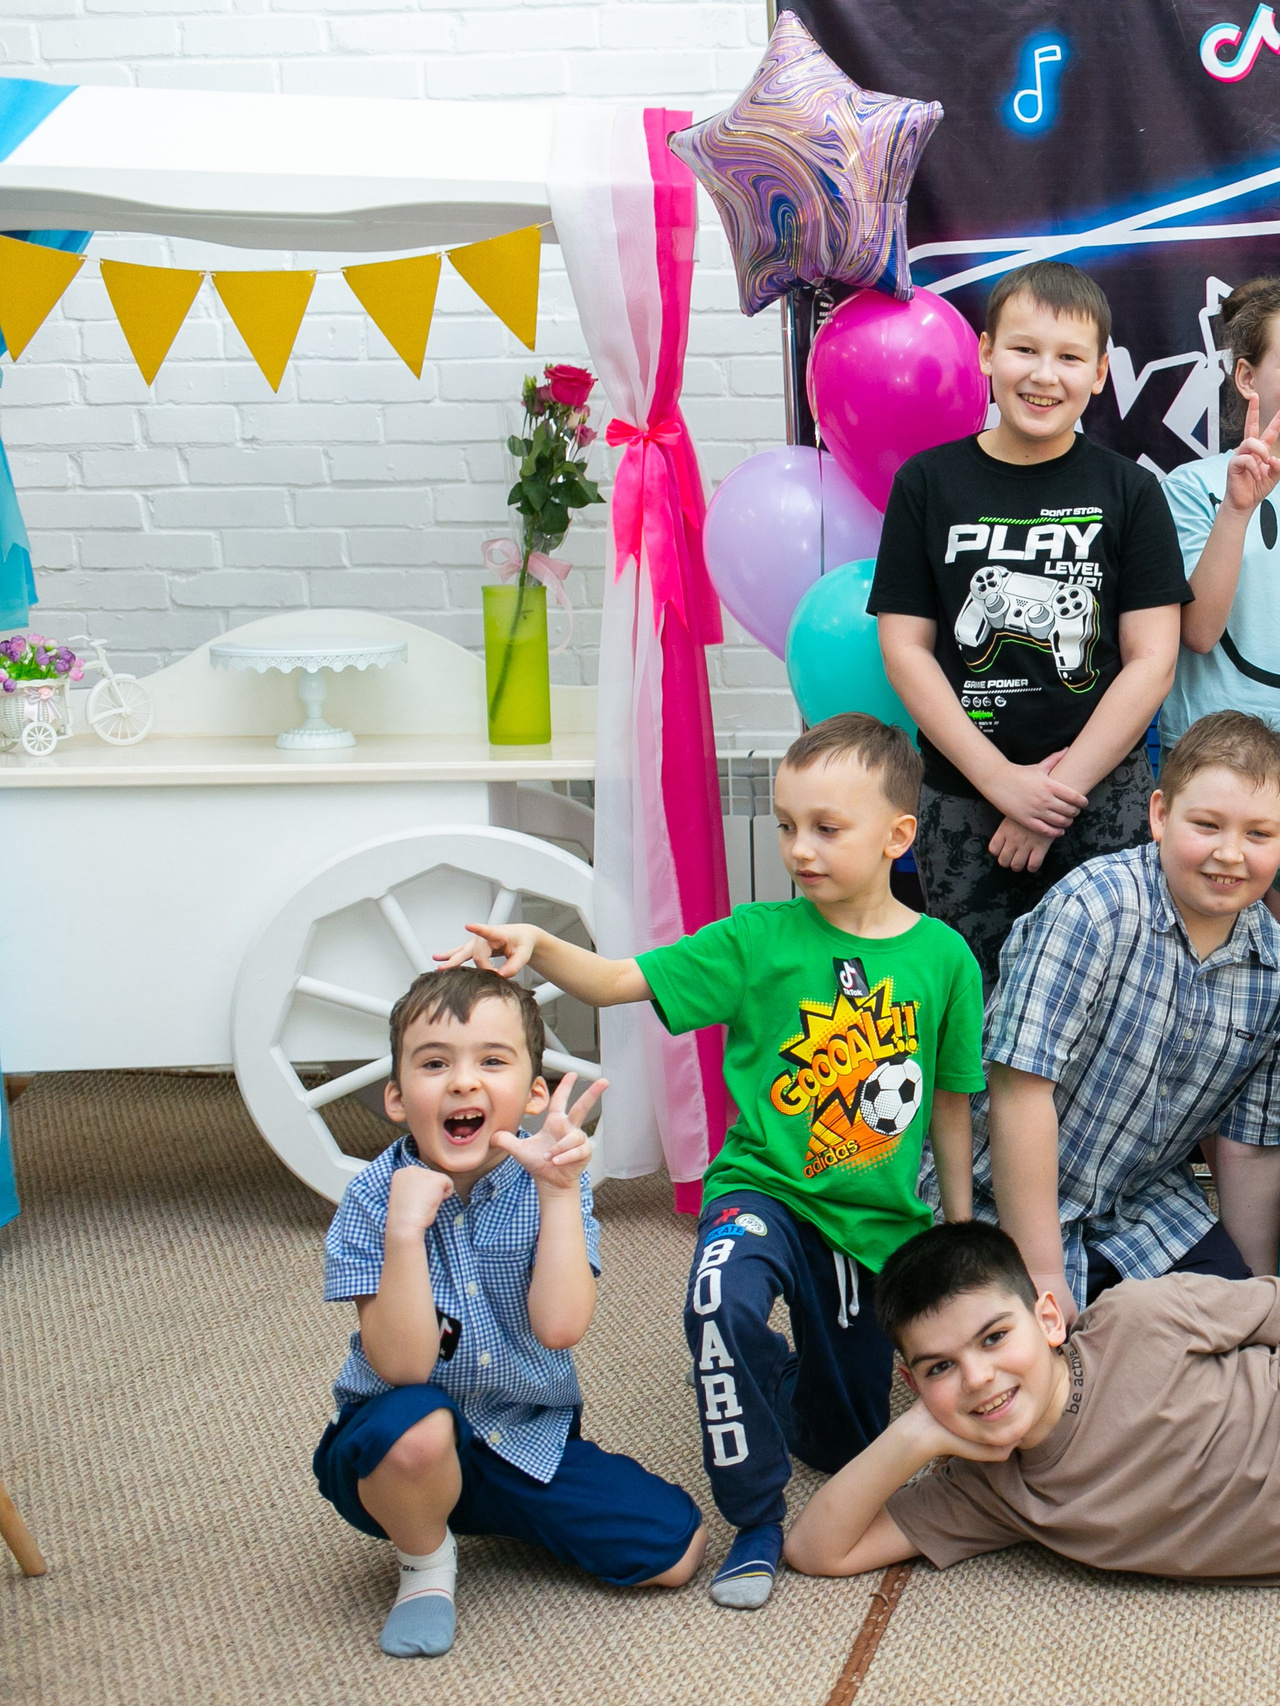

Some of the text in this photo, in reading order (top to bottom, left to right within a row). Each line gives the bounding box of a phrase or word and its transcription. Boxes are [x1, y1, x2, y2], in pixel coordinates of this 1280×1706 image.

[1073, 506, 1103, 516] STOP
[945, 523, 1103, 564] PLAY
[1044, 561, 1103, 577] LEVEL
[987, 678, 1029, 689] POWER
[803, 1138, 859, 1179] adidas
[693, 1238, 749, 1467] BOARD
[1064, 1348, 1084, 1415] be active
